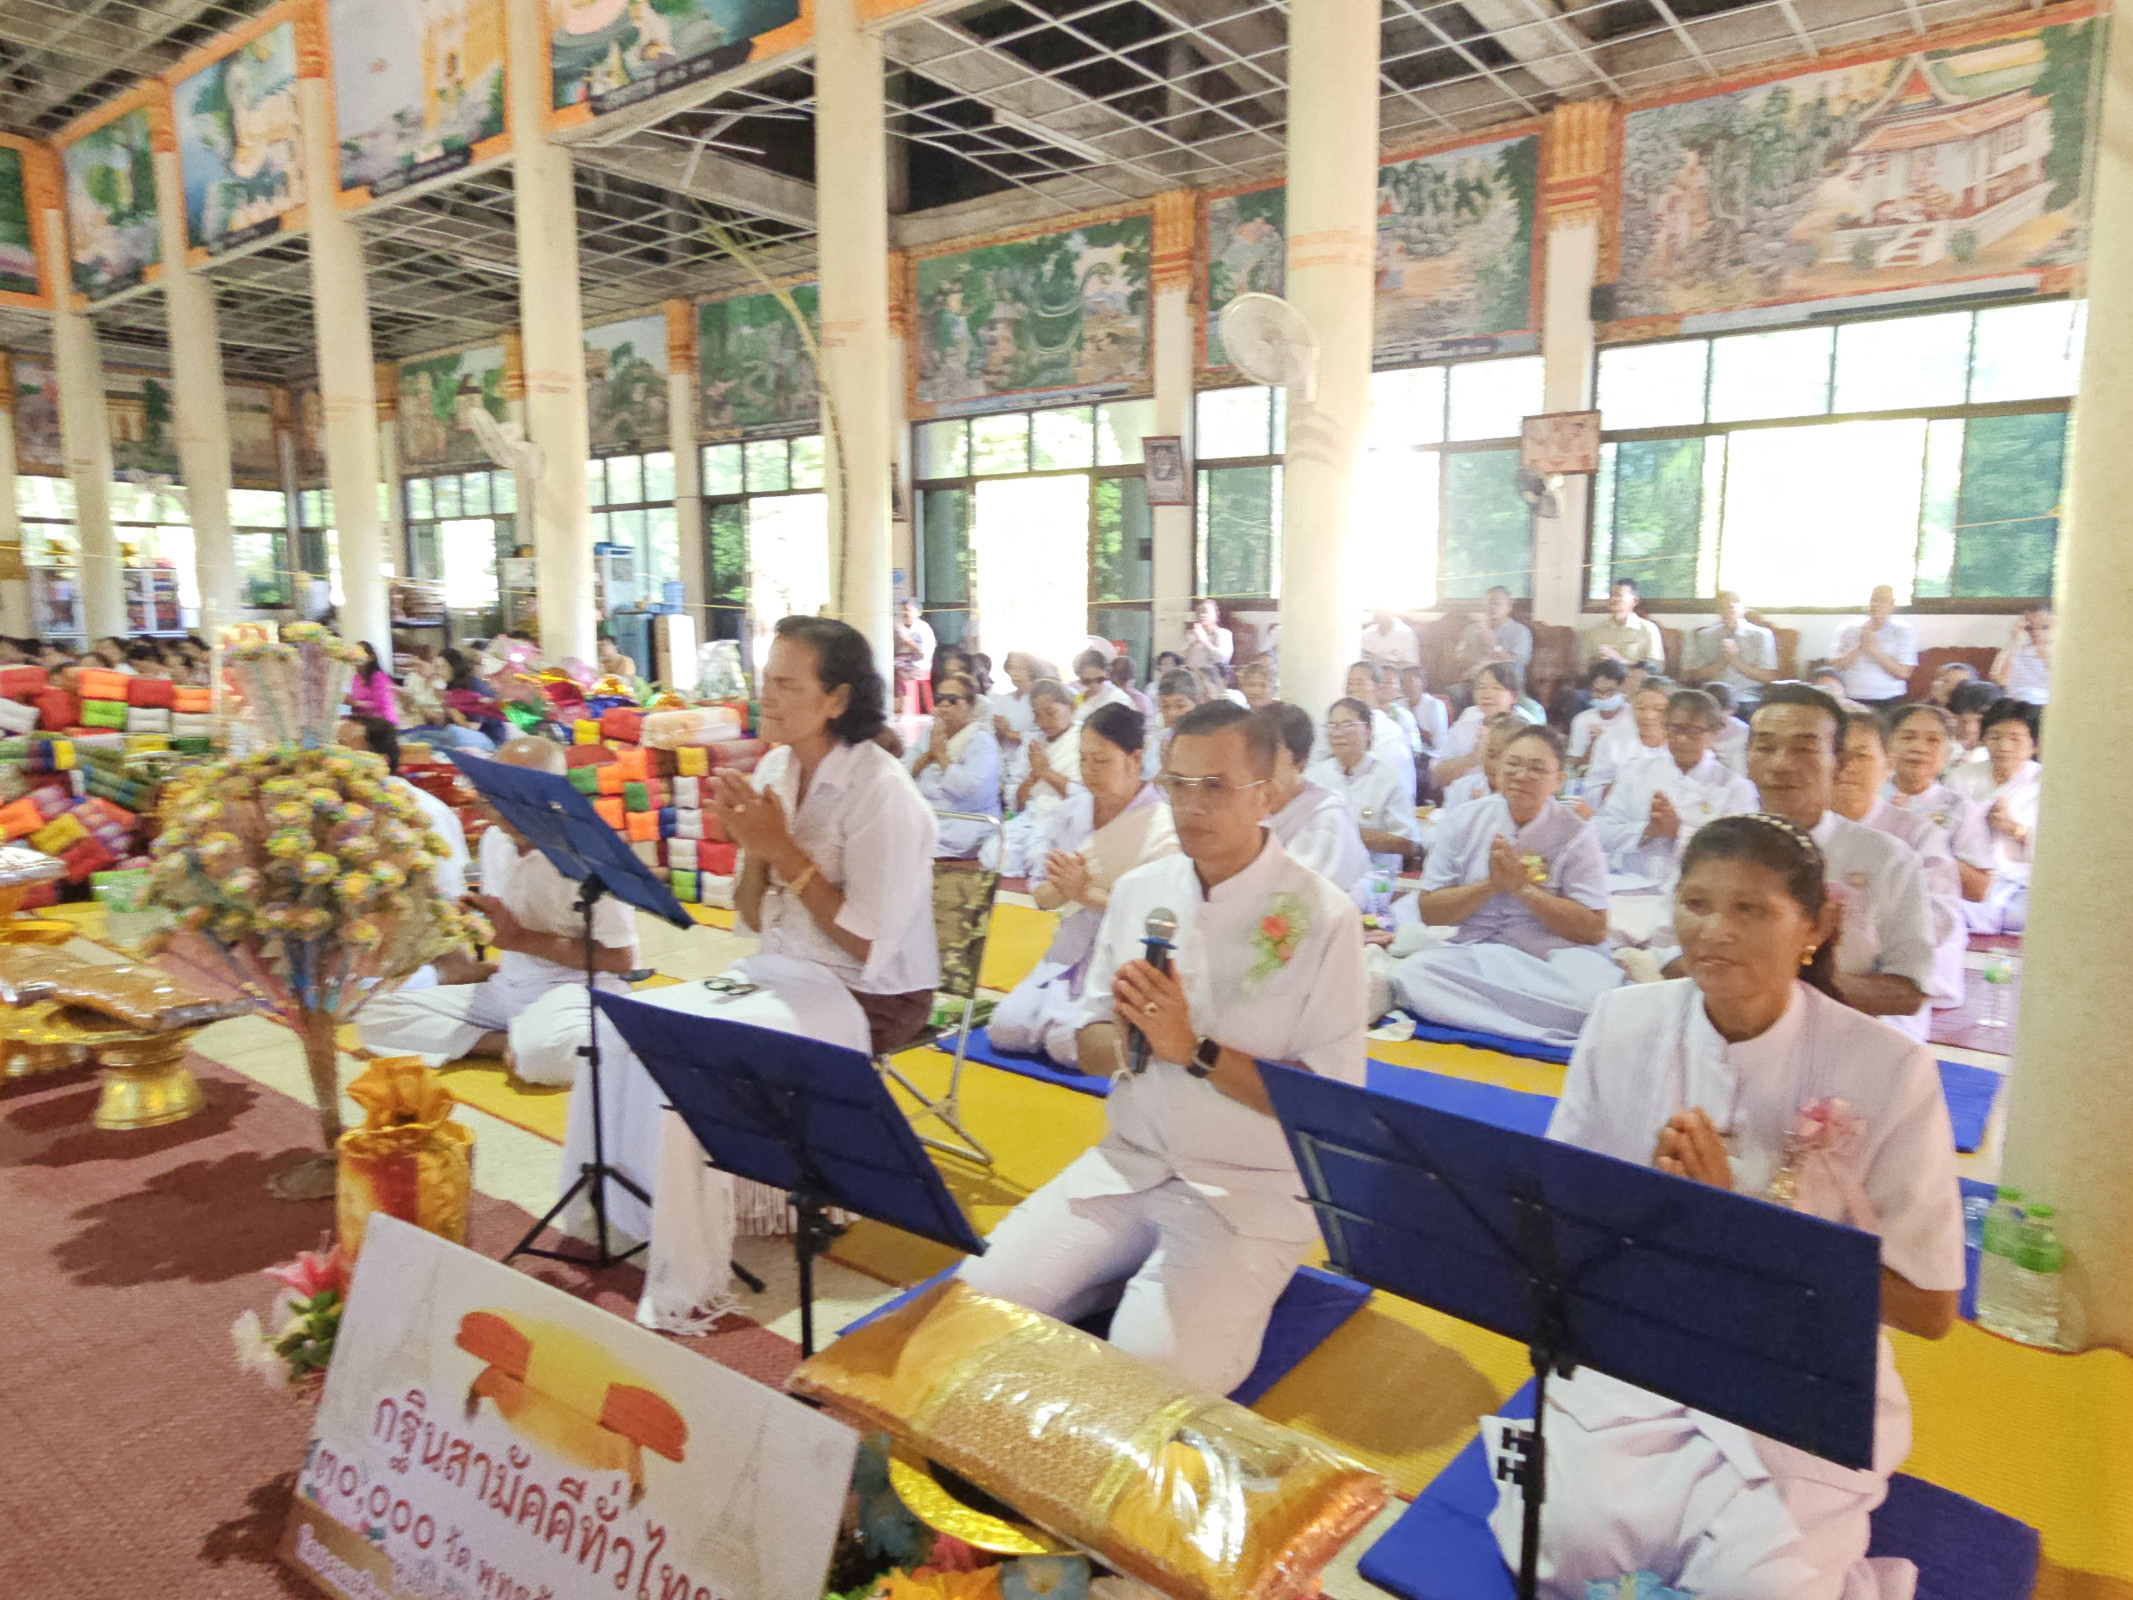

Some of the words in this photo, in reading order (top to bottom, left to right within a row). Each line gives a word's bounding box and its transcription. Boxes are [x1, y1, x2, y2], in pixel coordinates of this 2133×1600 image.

[372, 1387, 728, 1600] กฐินสามัคคีทั่วไท
